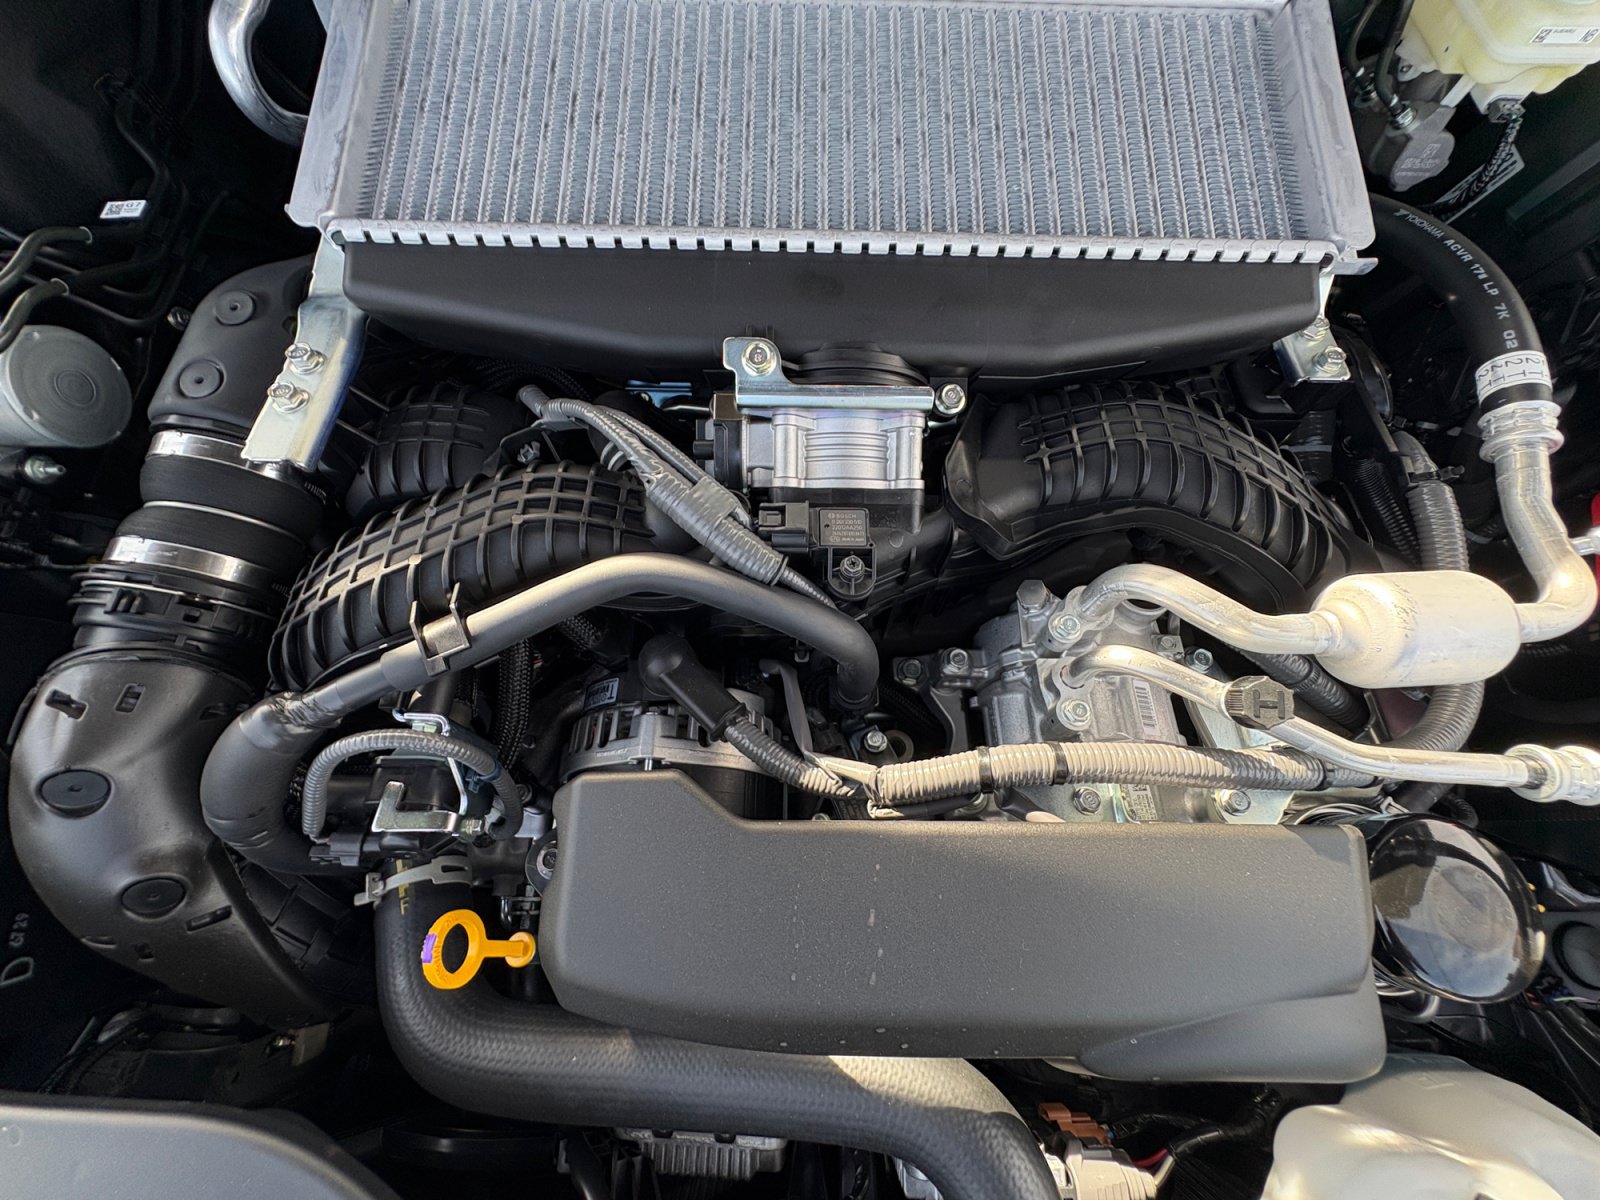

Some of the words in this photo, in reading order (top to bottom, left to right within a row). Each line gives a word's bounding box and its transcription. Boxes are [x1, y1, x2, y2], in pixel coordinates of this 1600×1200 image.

[1405, 212, 1446, 240] YOKOHAMA
[1443, 239, 1474, 263] ACVR
[1483, 281, 1499, 296] LP
[1493, 302, 1511, 320] 7K
[1503, 329, 1519, 349] 02
